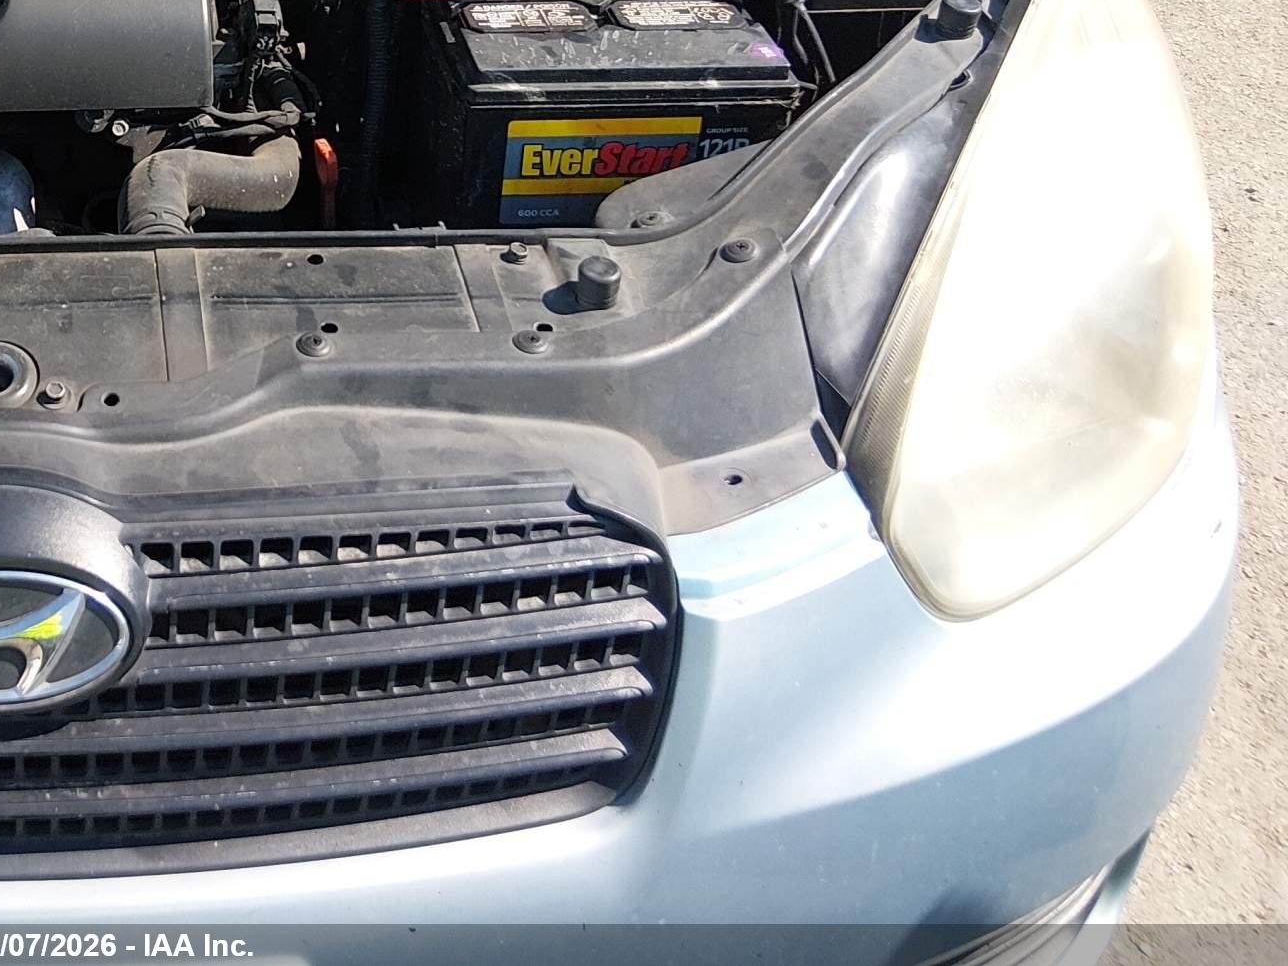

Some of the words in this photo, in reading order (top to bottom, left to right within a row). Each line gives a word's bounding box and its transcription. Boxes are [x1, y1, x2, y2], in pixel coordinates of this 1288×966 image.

[521, 141, 689, 176] EverStart
[517, 209, 537, 218] 600
[539, 209, 559, 217] CCA
